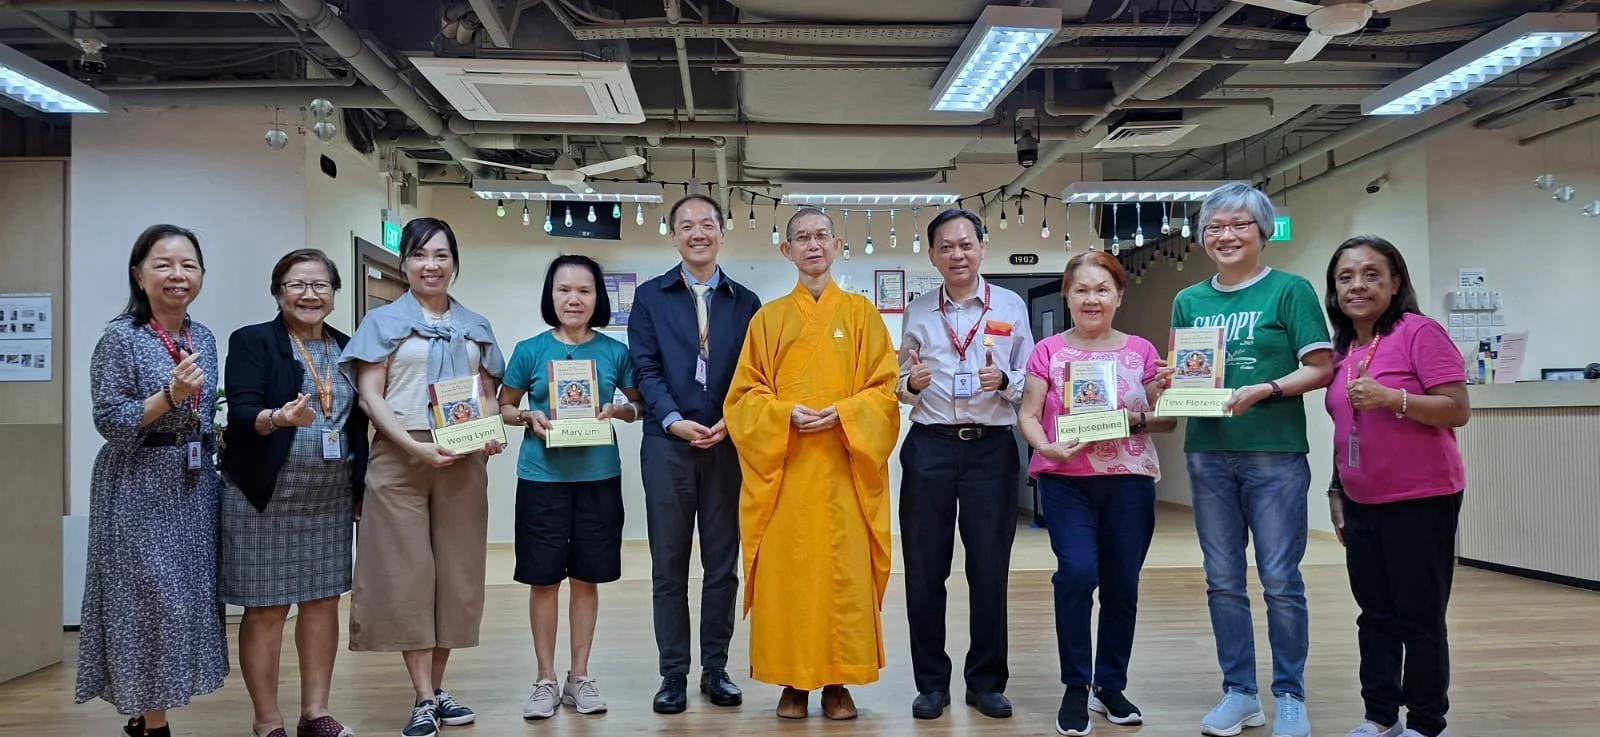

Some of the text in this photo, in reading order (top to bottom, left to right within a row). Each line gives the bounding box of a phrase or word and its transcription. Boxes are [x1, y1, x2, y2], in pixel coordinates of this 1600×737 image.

[386, 227, 398, 247] EXIT
[1273, 222, 1286, 237] IT
[1014, 255, 1034, 263] 1902
[1078, 421, 1122, 434] Josephine
[447, 429, 496, 445] Wong Lynn
